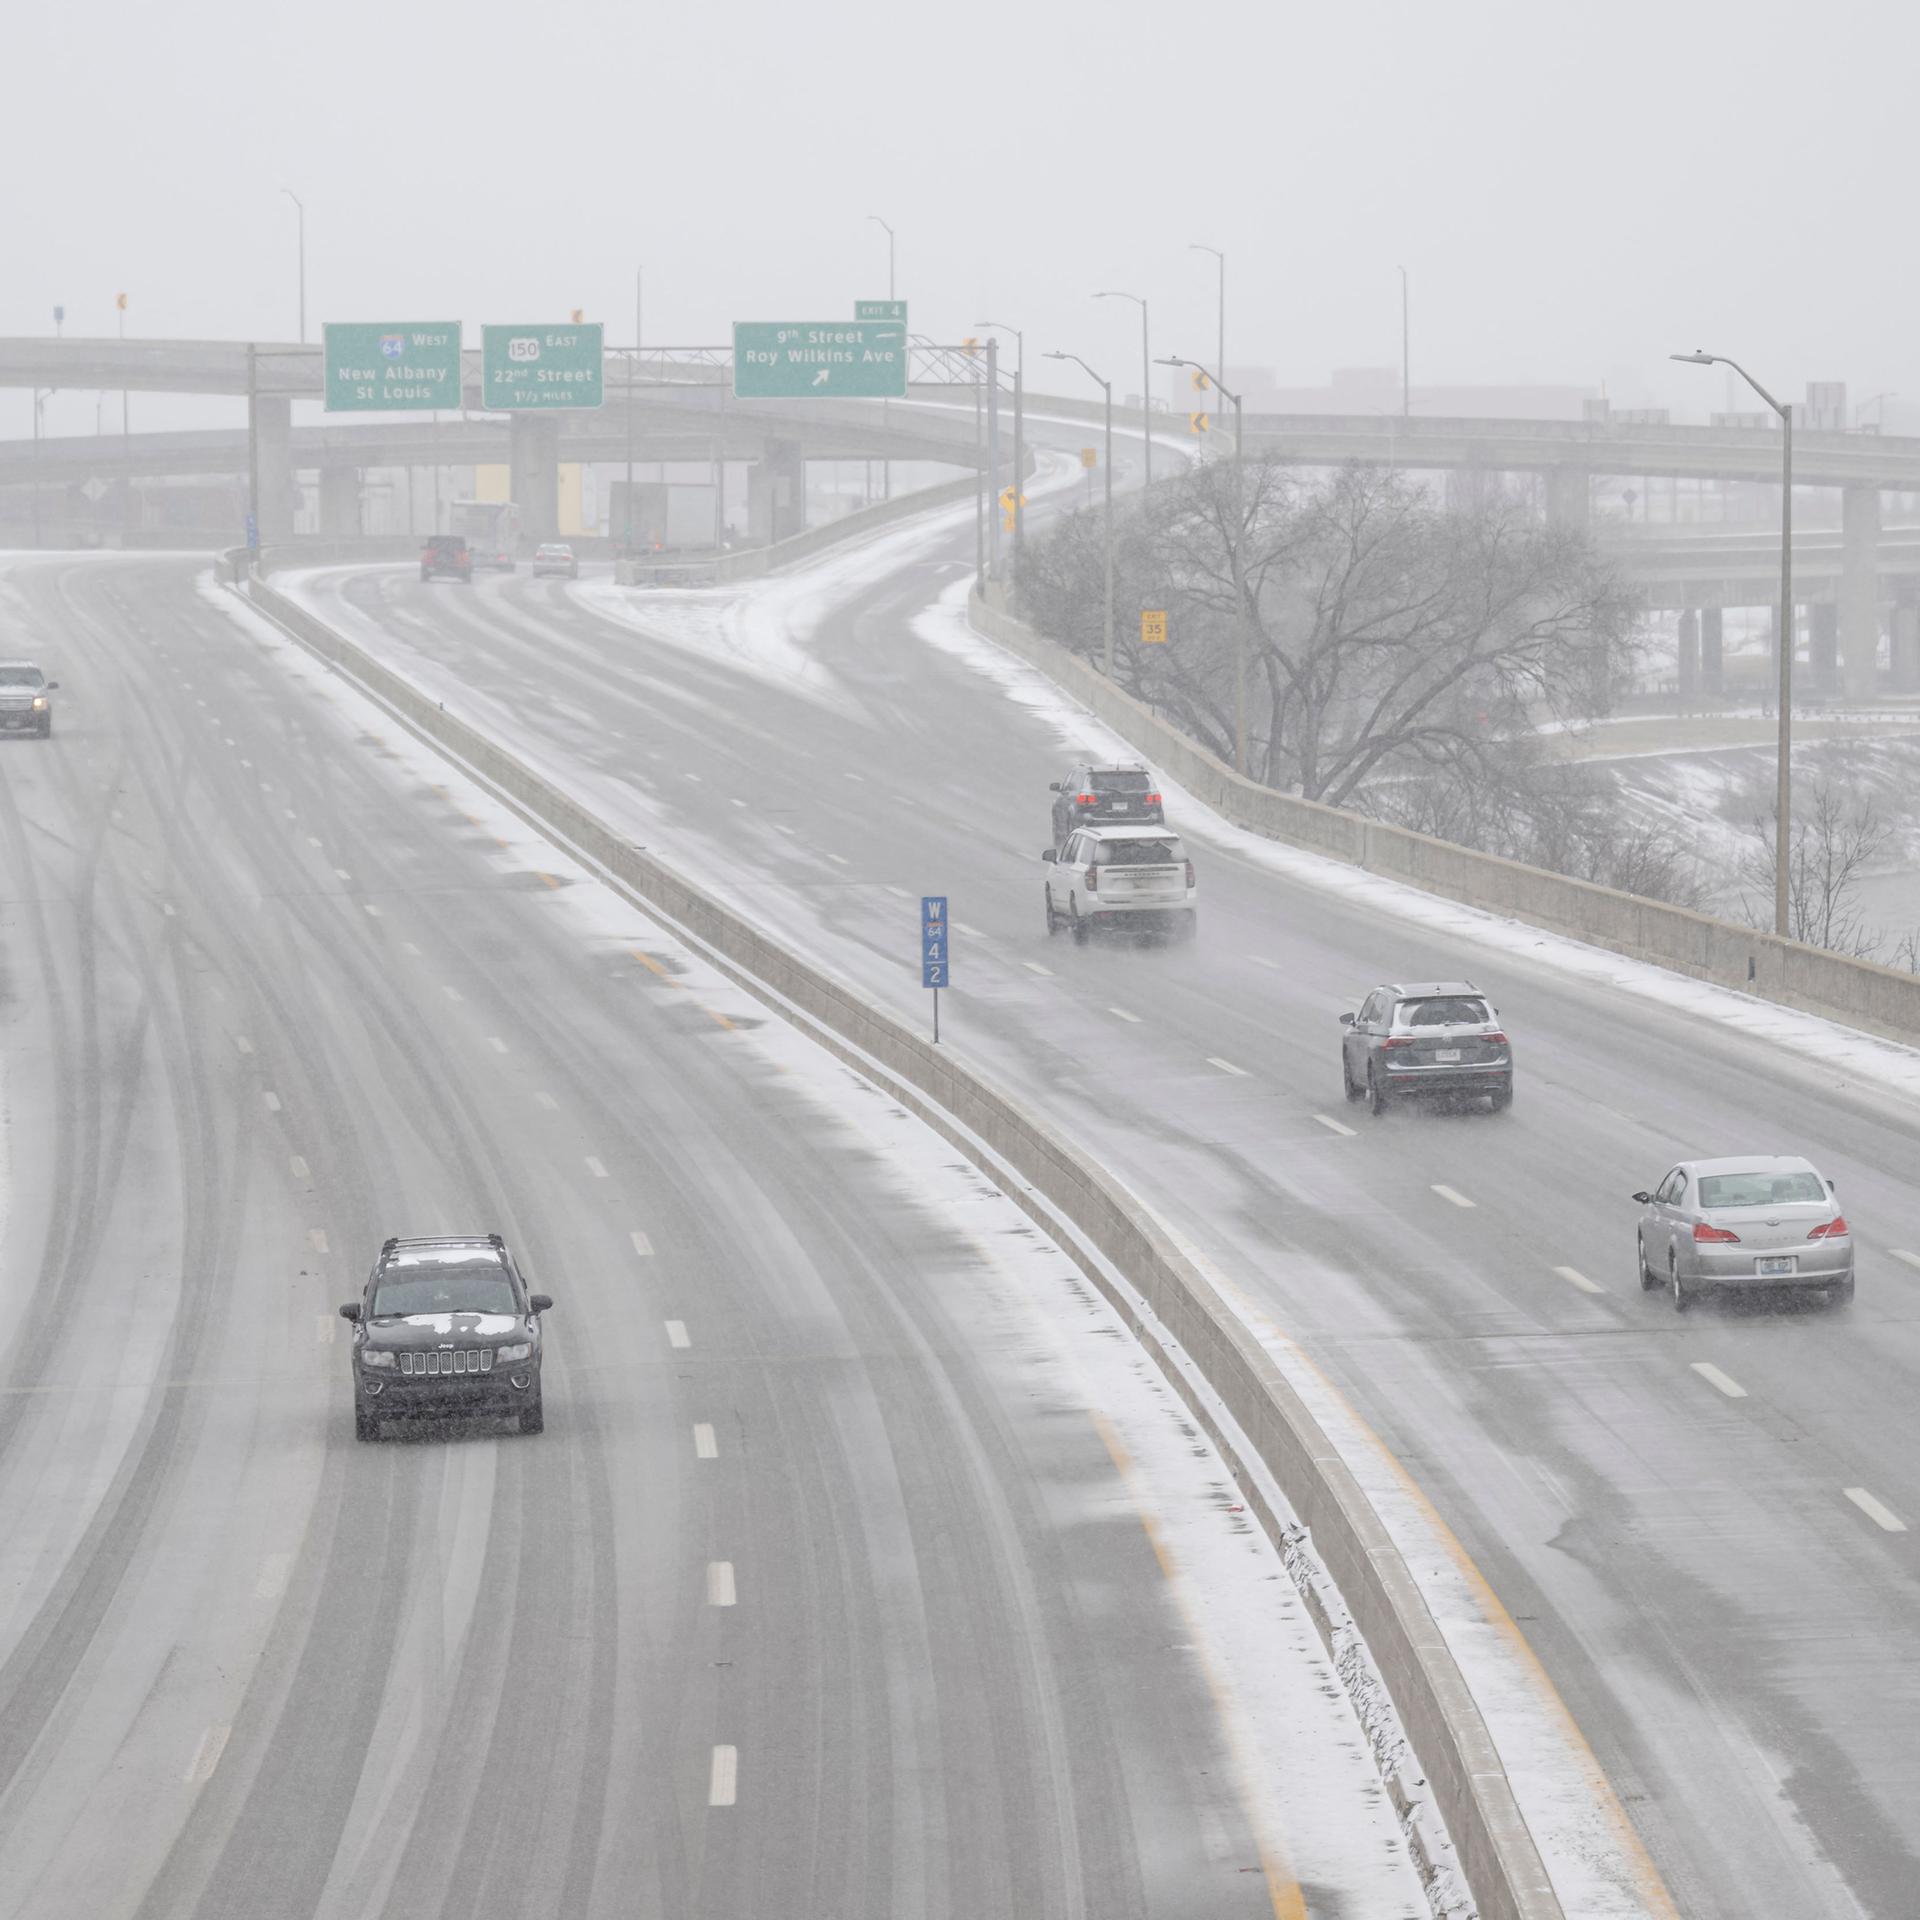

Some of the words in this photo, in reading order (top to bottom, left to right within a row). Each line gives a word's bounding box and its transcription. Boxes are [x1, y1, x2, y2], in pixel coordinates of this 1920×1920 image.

[890, 305, 900, 317] 4
[382, 342, 402, 354] 64
[411, 334, 448, 346] WEST
[777, 329, 799, 344] 9th
[808, 330, 864, 344] Street
[511, 342, 537, 356] 150
[545, 335, 577, 347] EAST
[746, 350, 778, 366] Roy
[787, 349, 853, 363] Wilkins
[862, 350, 895, 363] Ave
[338, 367, 376, 380] New
[385, 366, 447, 382] Albany
[494, 368, 529, 383] 22nd
[536, 369, 593, 382] Street
[356, 385, 374, 399] St
[383, 384, 432, 399] Louis
[543, 391, 573, 401] MILES
[1146, 624, 1162, 634] 35
[928, 902, 941, 919] W
[928, 927, 941, 937] 64
[928, 943, 940, 959] 4
[930, 966, 941, 983] 2
